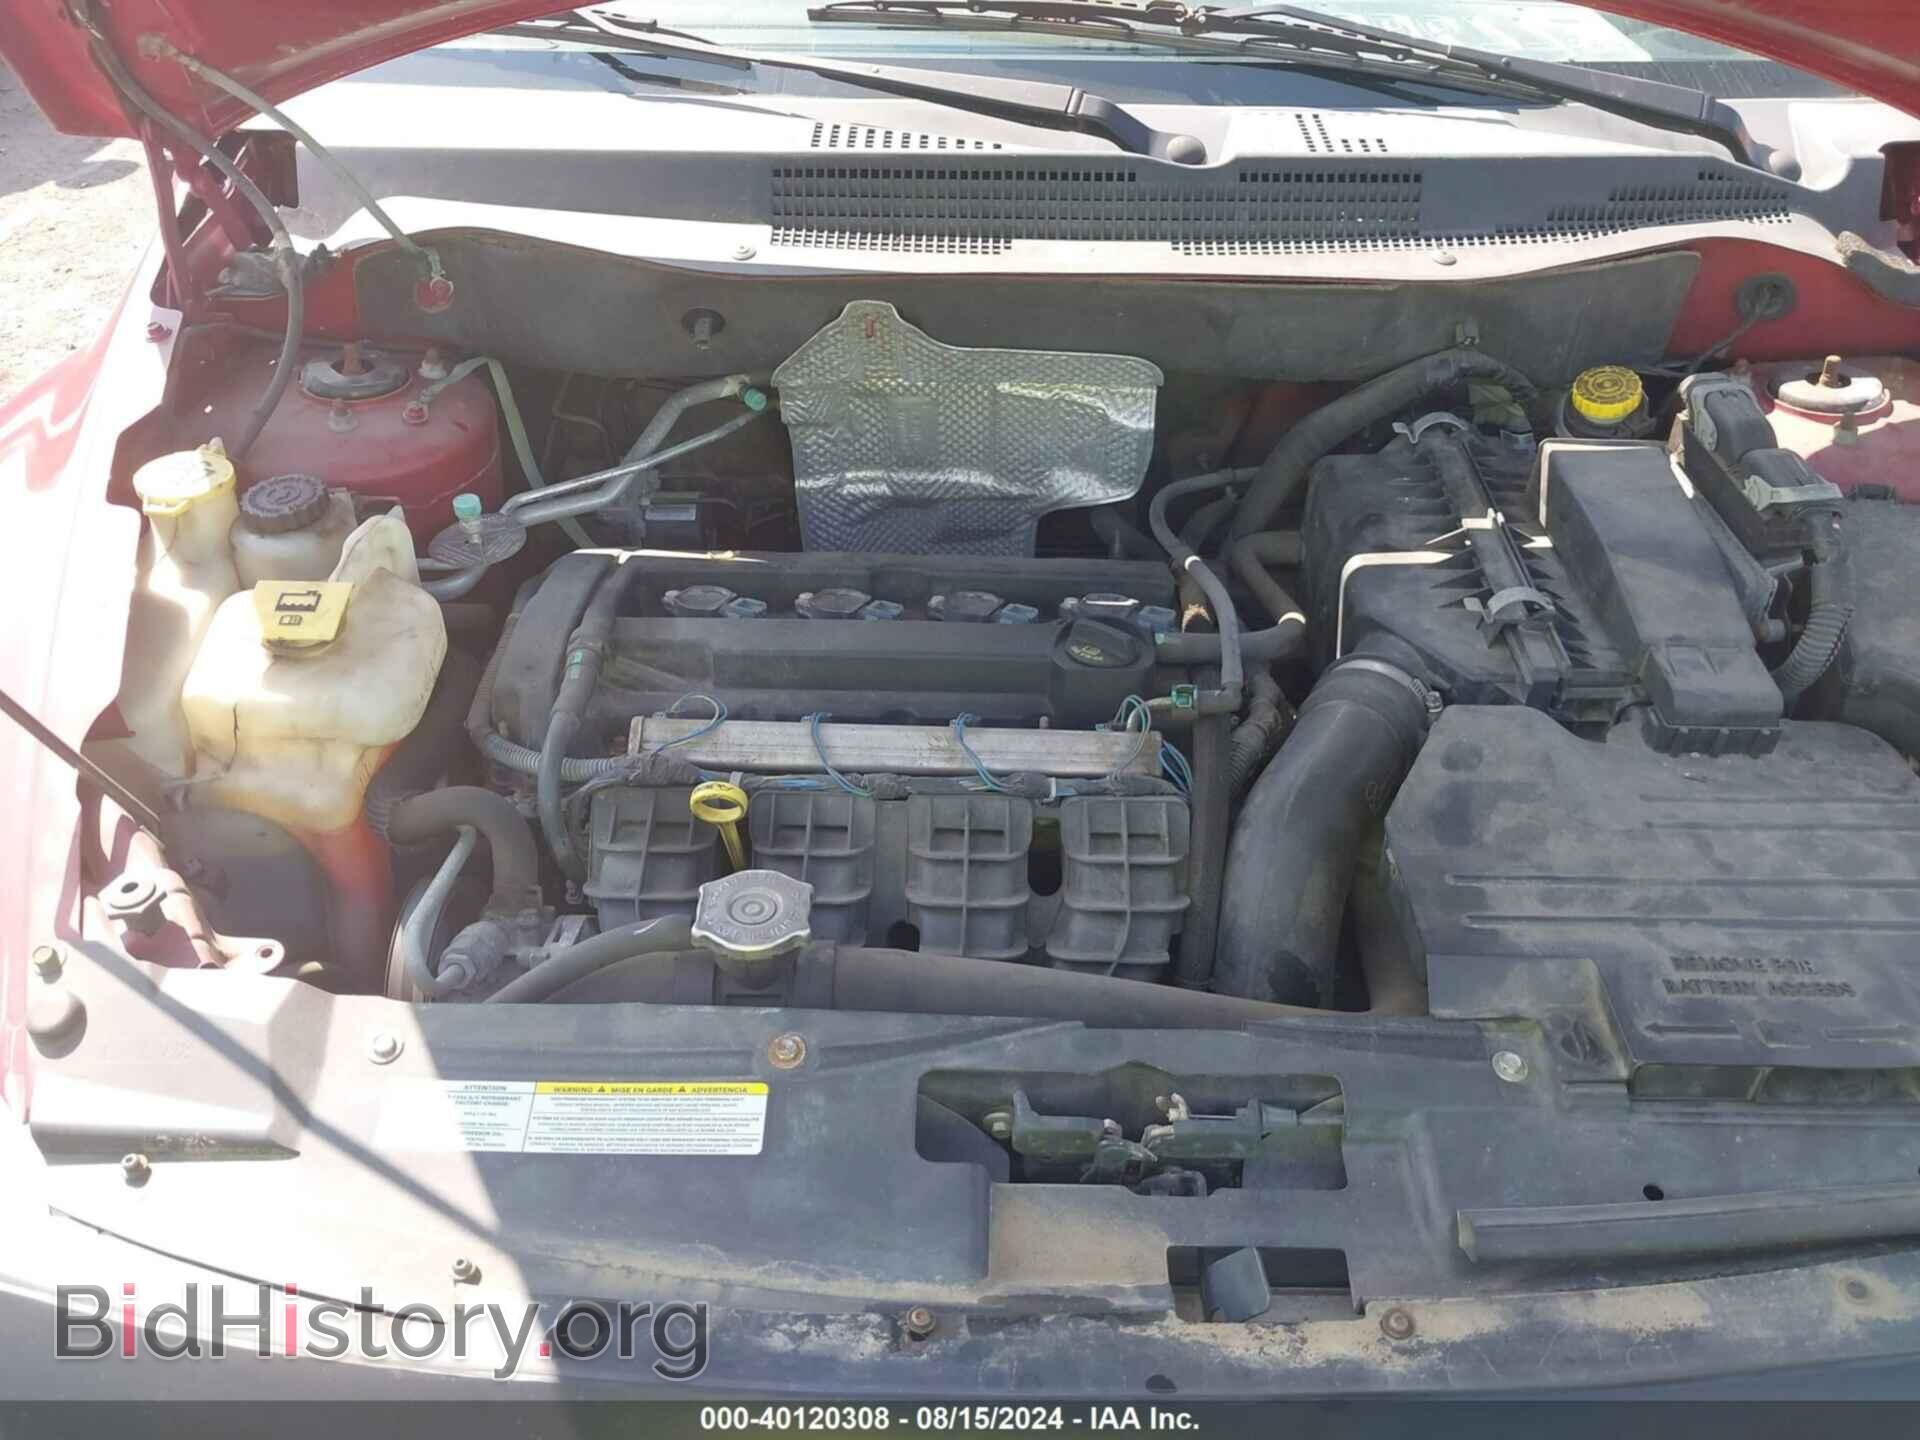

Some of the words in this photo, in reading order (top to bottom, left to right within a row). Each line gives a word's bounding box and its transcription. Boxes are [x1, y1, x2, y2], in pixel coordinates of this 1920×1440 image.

[1670, 956, 1768, 973] REMOVE
[1662, 978, 1757, 995] BATTERY
[553, 1086, 594, 1094] WARNING
